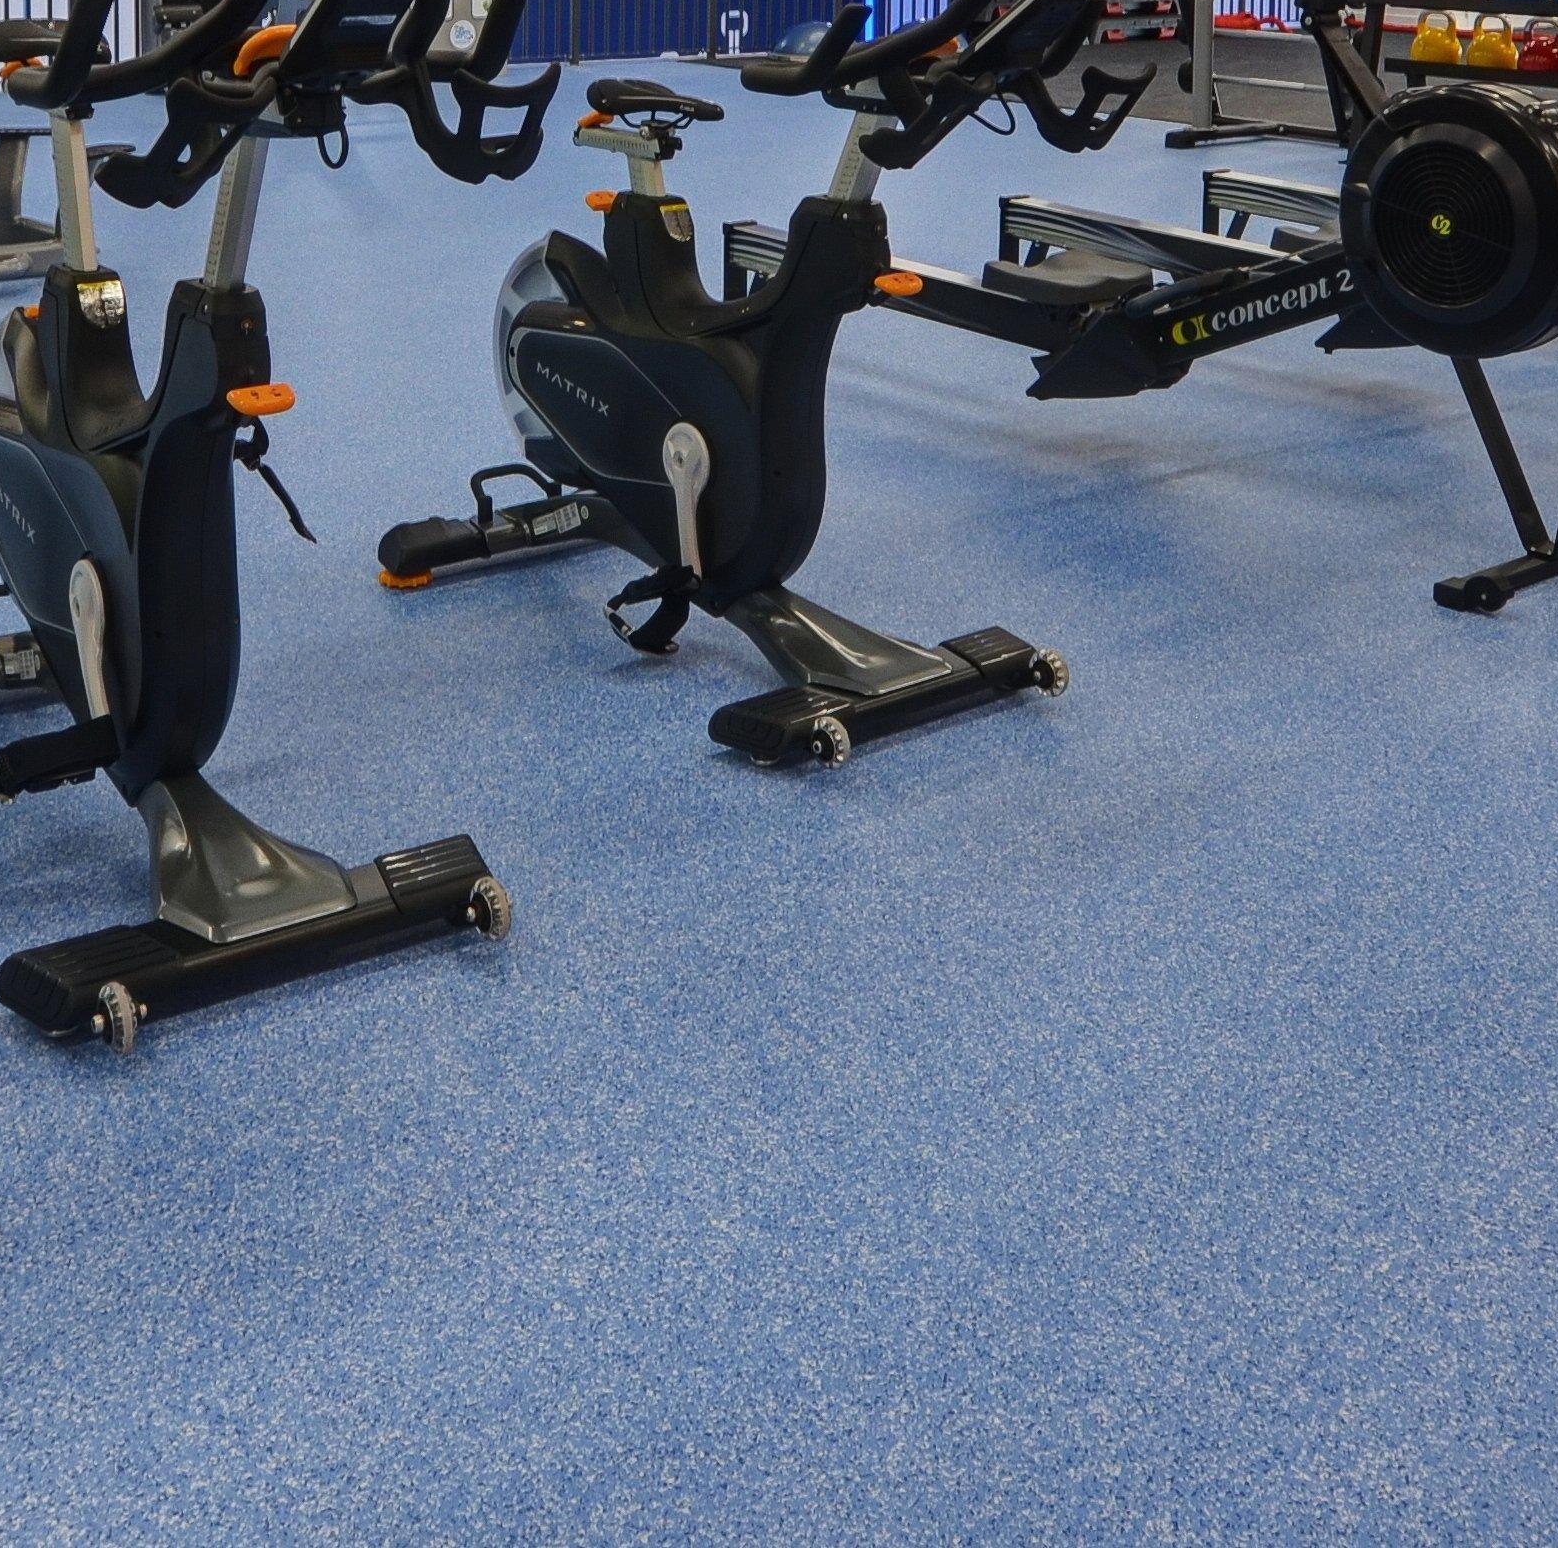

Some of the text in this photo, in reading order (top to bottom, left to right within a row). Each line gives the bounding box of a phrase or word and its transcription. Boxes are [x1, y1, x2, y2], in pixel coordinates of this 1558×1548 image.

[1211, 276, 1332, 332] concept
[1336, 269, 1355, 292] 2
[536, 361, 609, 417] MATRIX
